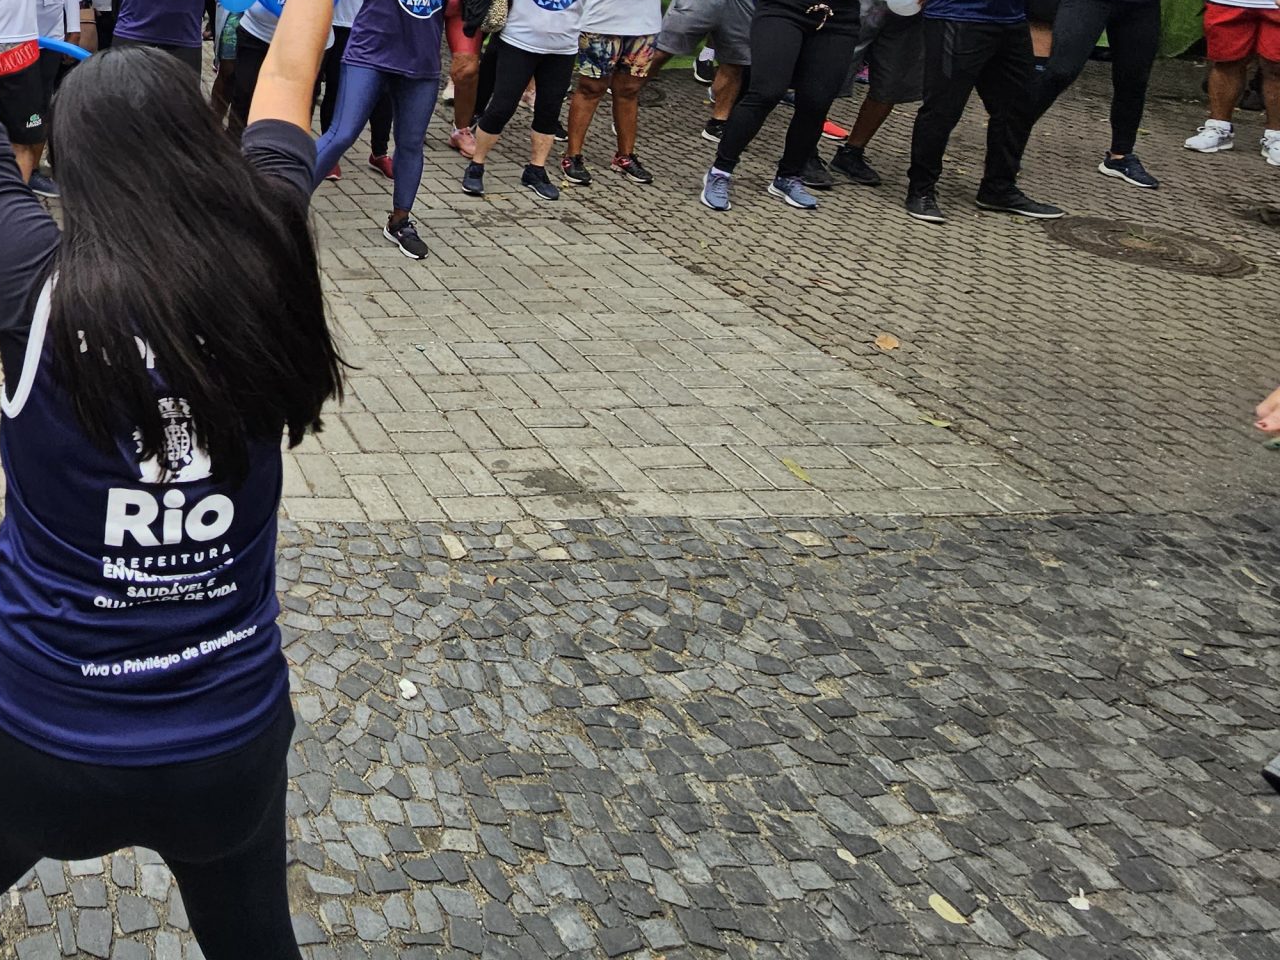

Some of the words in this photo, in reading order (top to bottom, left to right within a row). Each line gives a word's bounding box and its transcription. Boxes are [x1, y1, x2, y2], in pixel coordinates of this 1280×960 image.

[103, 488, 235, 547] Rio
[102, 543, 232, 569] PREFEITURA
[126, 582, 205, 598] SAUDÁVEL
[184, 592, 205, 600] DE
[207, 582, 238, 599] VIDA
[81, 663, 109, 677] Viva
[112, 664, 122, 675] o
[124, 654, 181, 674] Privilégio
[182, 646, 199, 660] de
[200, 625, 258, 655] Envelhecer
